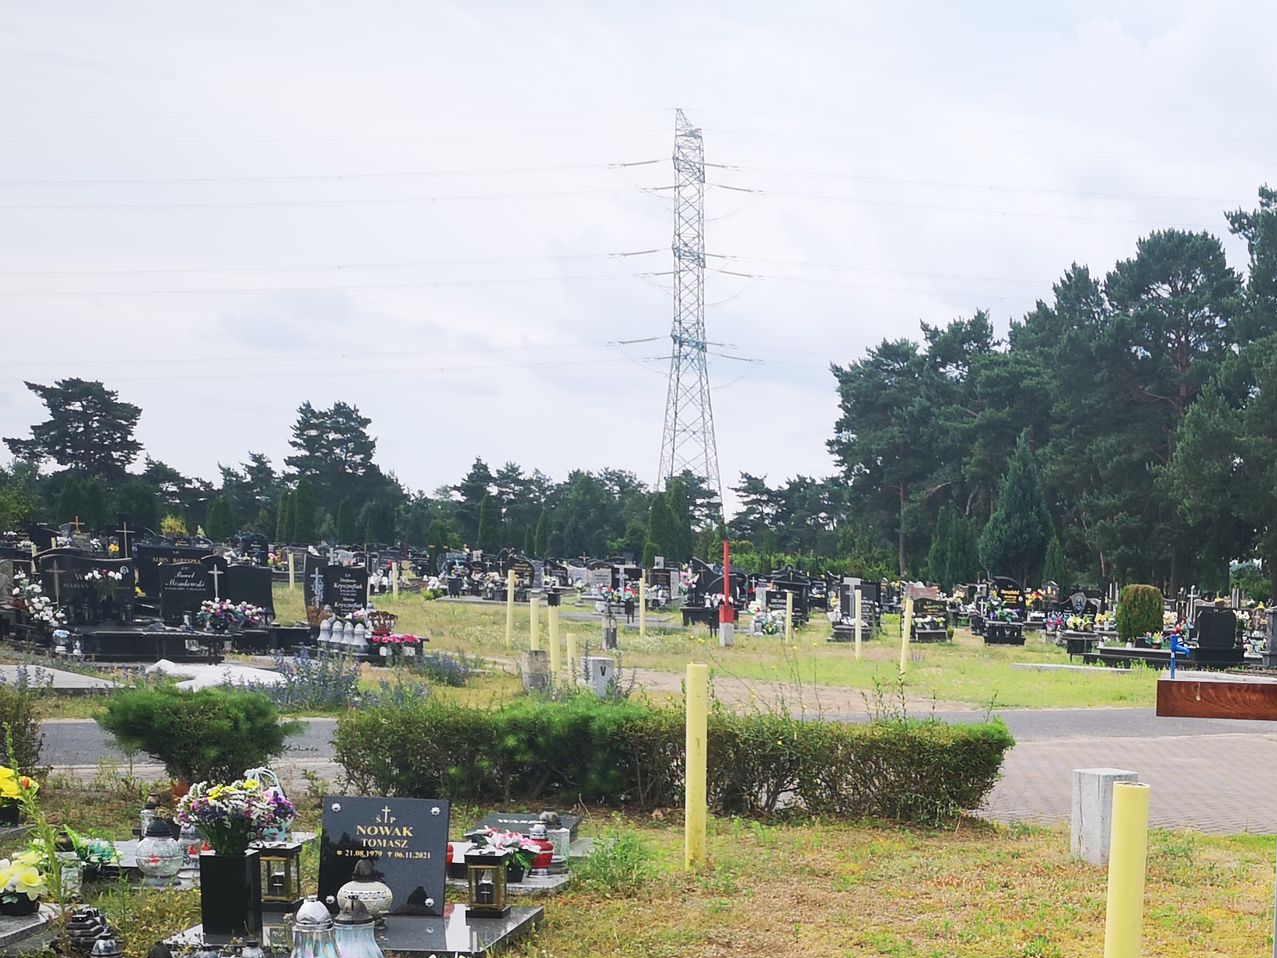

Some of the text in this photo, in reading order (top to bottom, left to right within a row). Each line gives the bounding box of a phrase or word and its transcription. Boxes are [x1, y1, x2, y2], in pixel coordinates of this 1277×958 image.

[599, 665, 606, 677] V
[356, 825, 414, 837] NOWAK
[361, 838, 409, 848] TOMASZ
